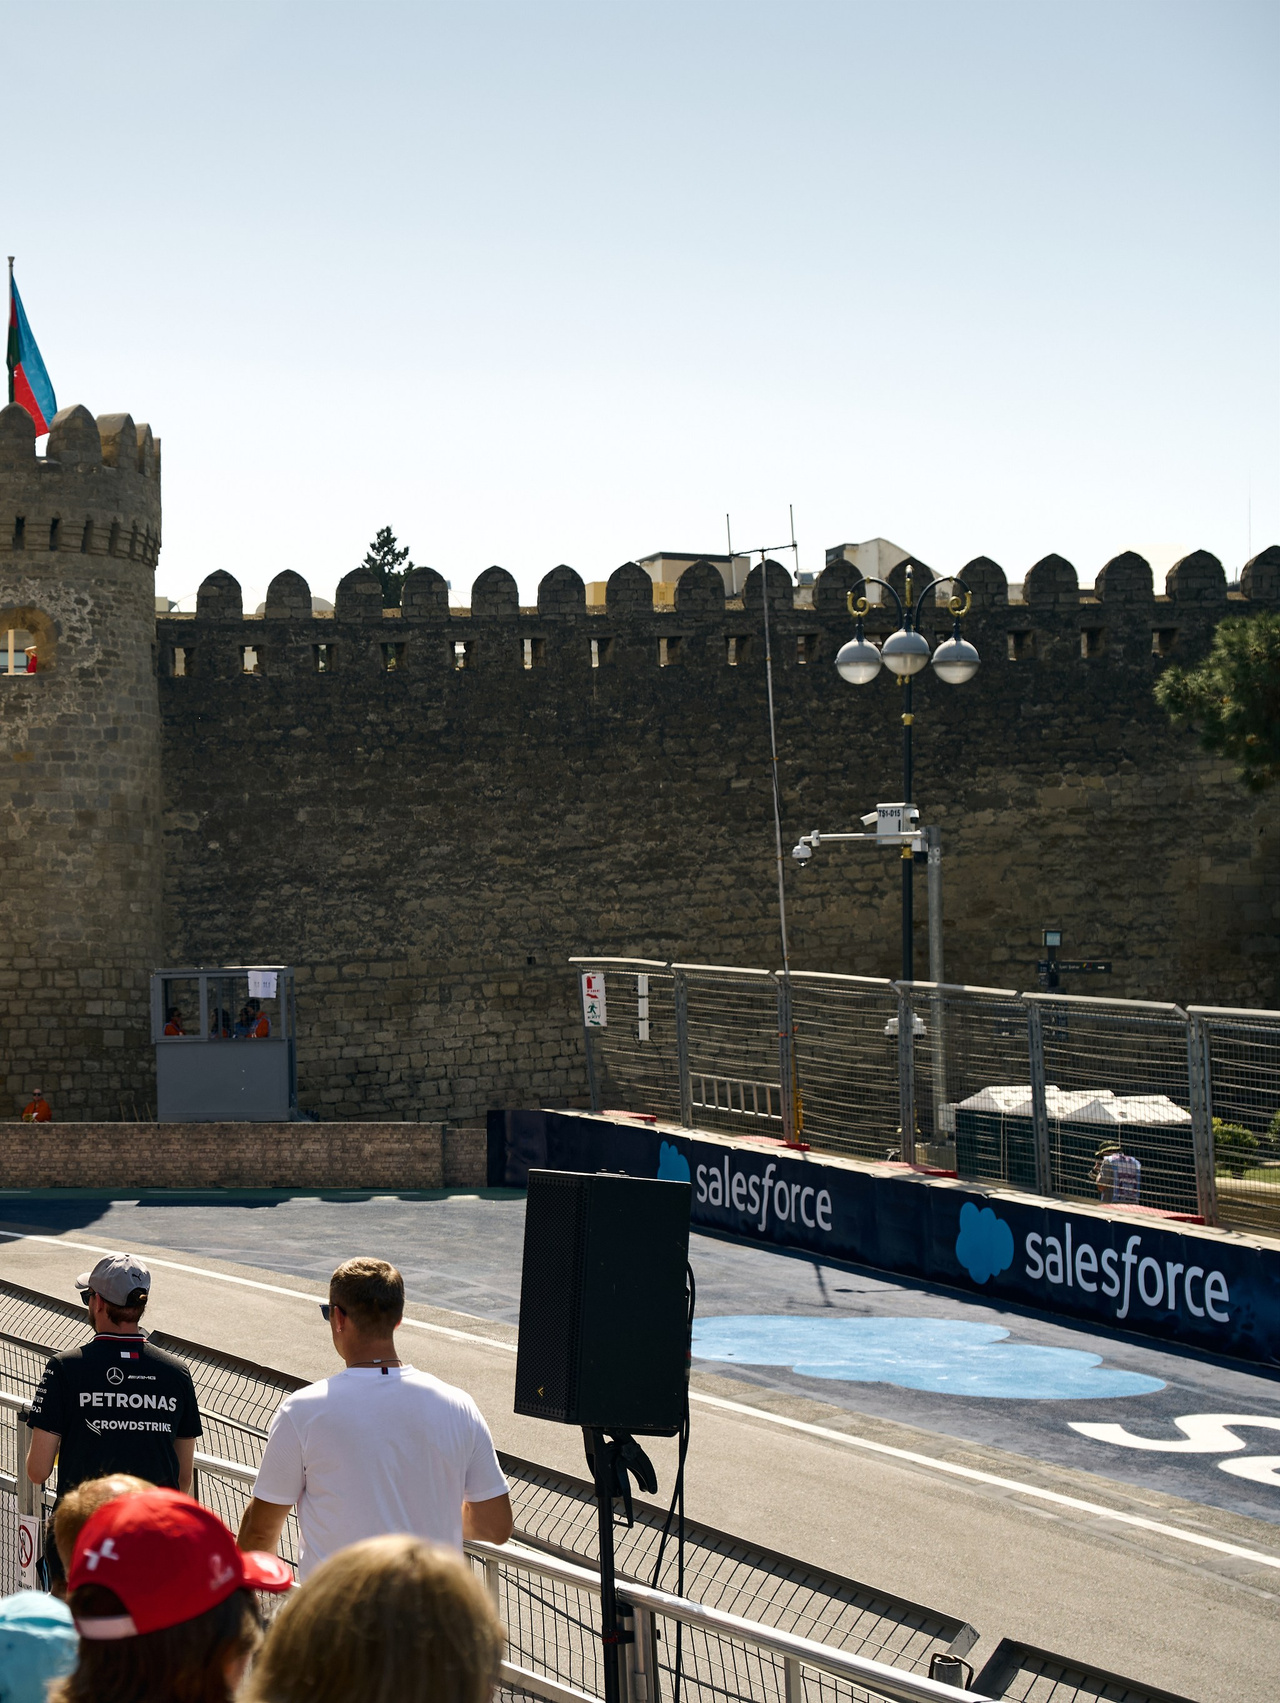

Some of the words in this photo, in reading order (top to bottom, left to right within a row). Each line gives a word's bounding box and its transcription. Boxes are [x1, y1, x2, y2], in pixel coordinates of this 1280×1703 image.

[696, 1155, 833, 1232] salesforce
[1025, 1222, 1230, 1323] salesforce
[79, 1392, 177, 1412] PETRONAS
[92, 1419, 172, 1433] CROWDSTRIKE
